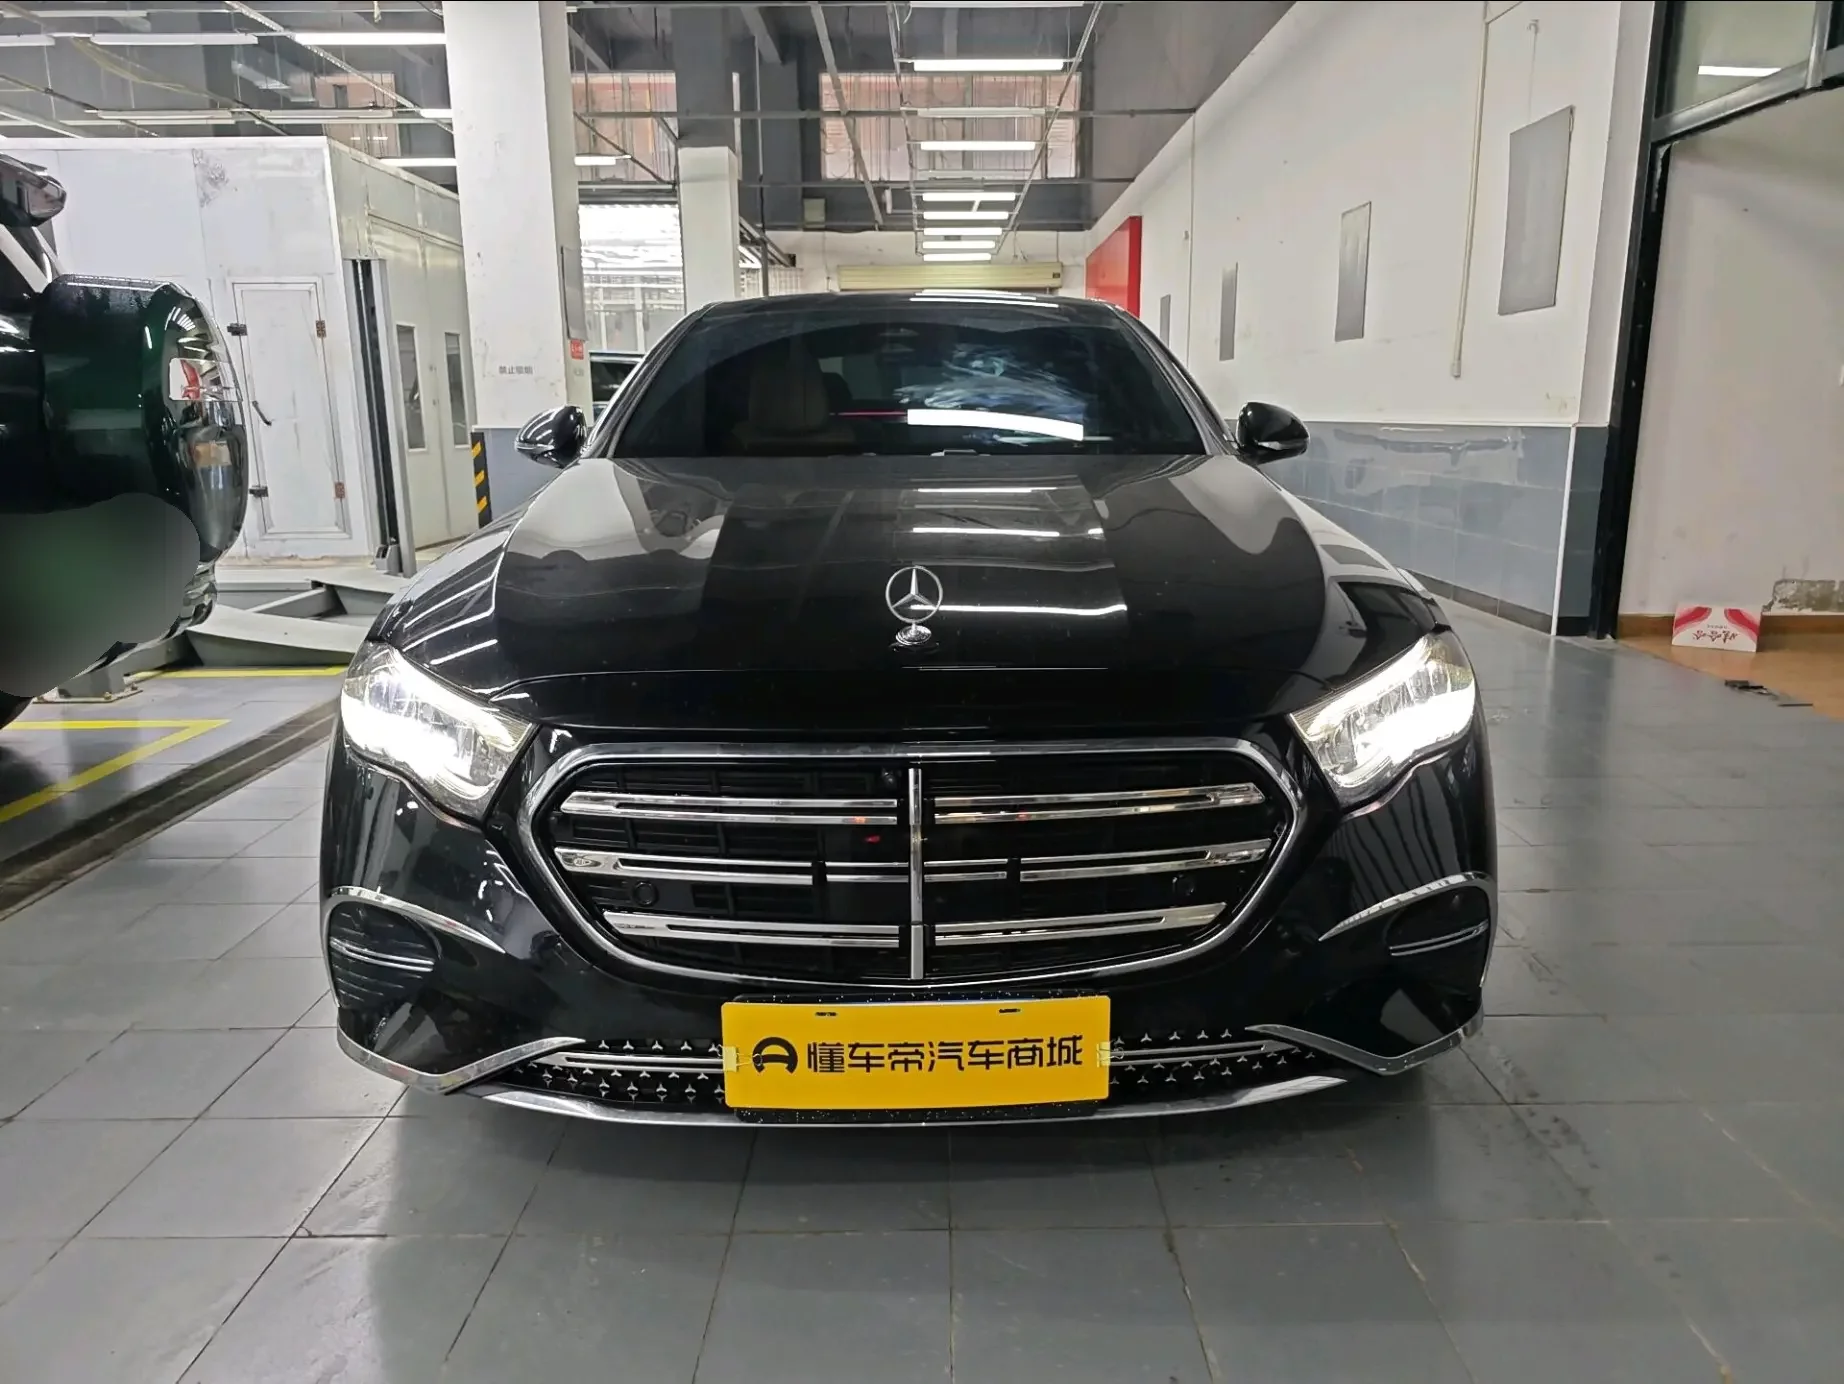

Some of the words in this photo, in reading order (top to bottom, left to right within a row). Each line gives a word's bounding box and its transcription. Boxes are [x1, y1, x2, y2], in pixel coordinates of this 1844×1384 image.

[806, 1035, 1084, 1074] 懂车帝汽车商城
